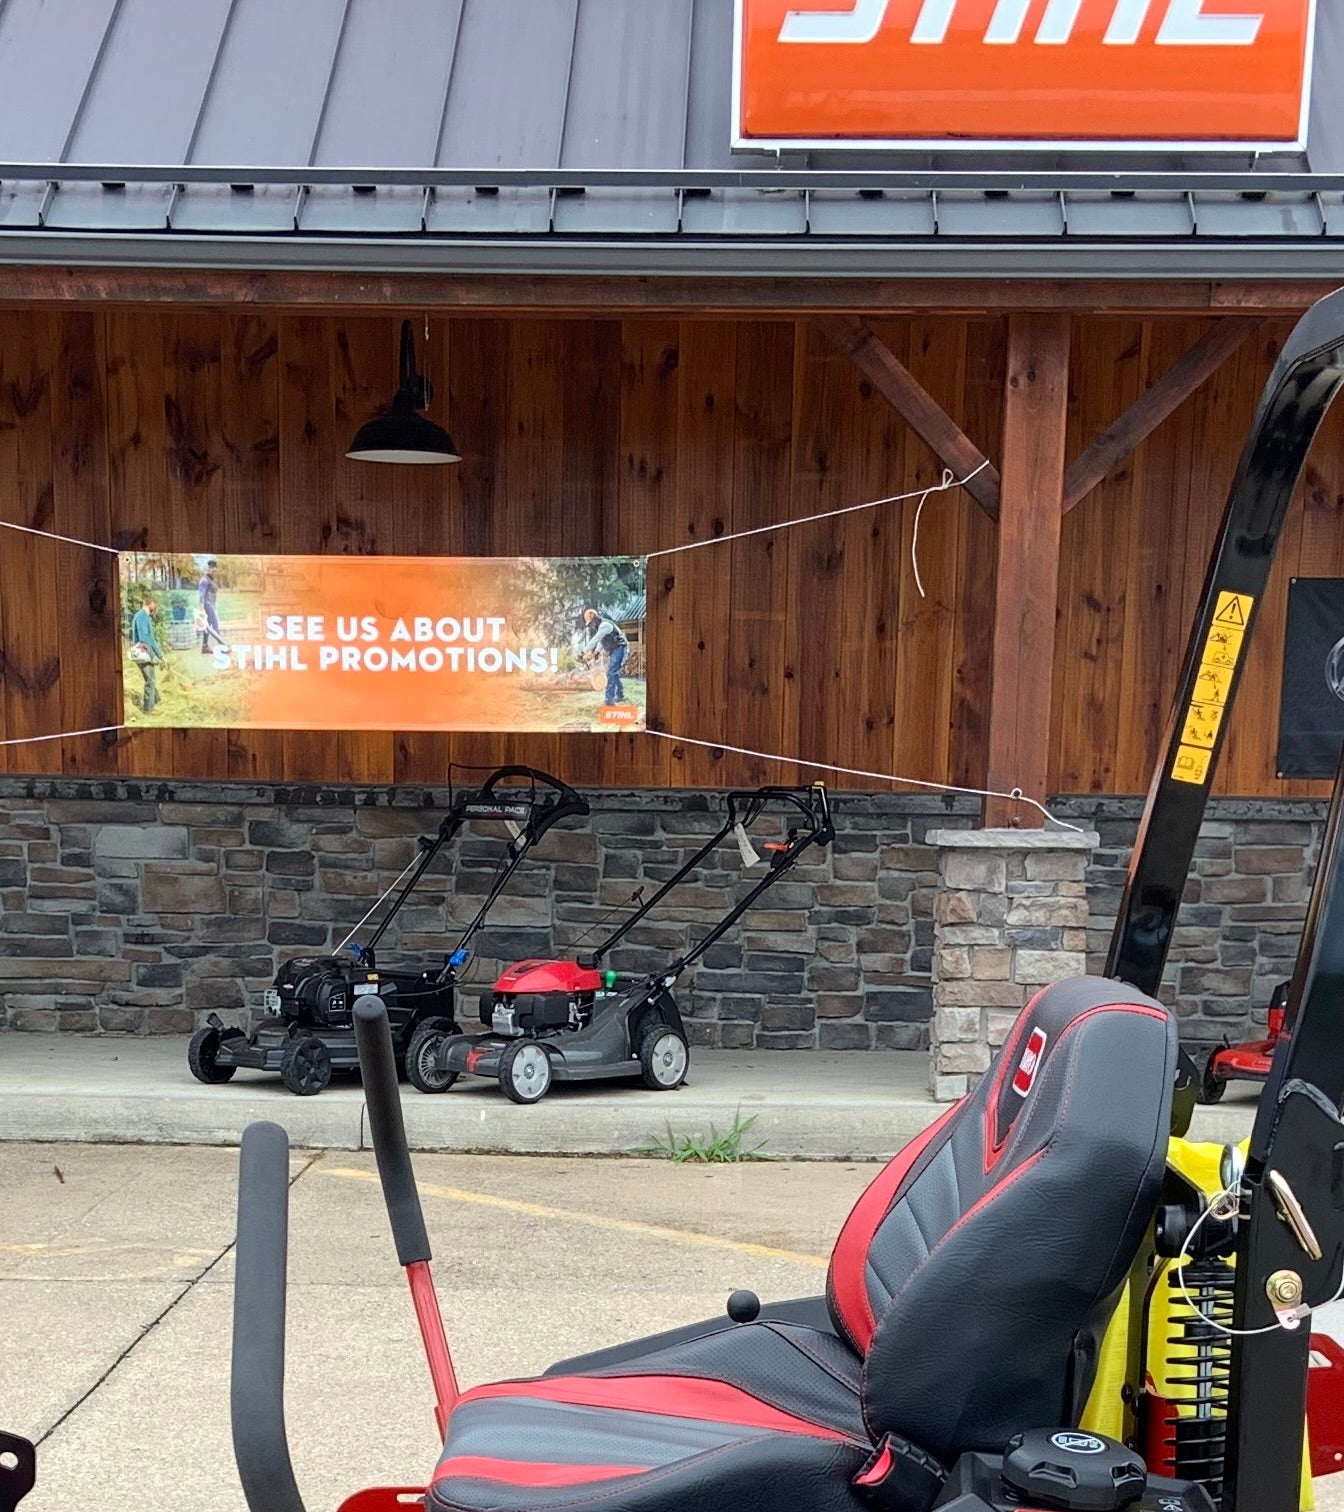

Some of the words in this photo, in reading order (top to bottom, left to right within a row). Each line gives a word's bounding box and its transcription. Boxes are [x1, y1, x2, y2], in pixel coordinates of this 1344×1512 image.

[265, 616, 325, 641] SEE
[337, 616, 379, 642] US
[389, 617, 506, 643] ABOUT
[211, 644, 308, 671] STIHL
[319, 646, 559, 674] PROMOTIONS!
[466, 805, 502, 813] PERSONAL
[504, 805, 526, 814] PACE
